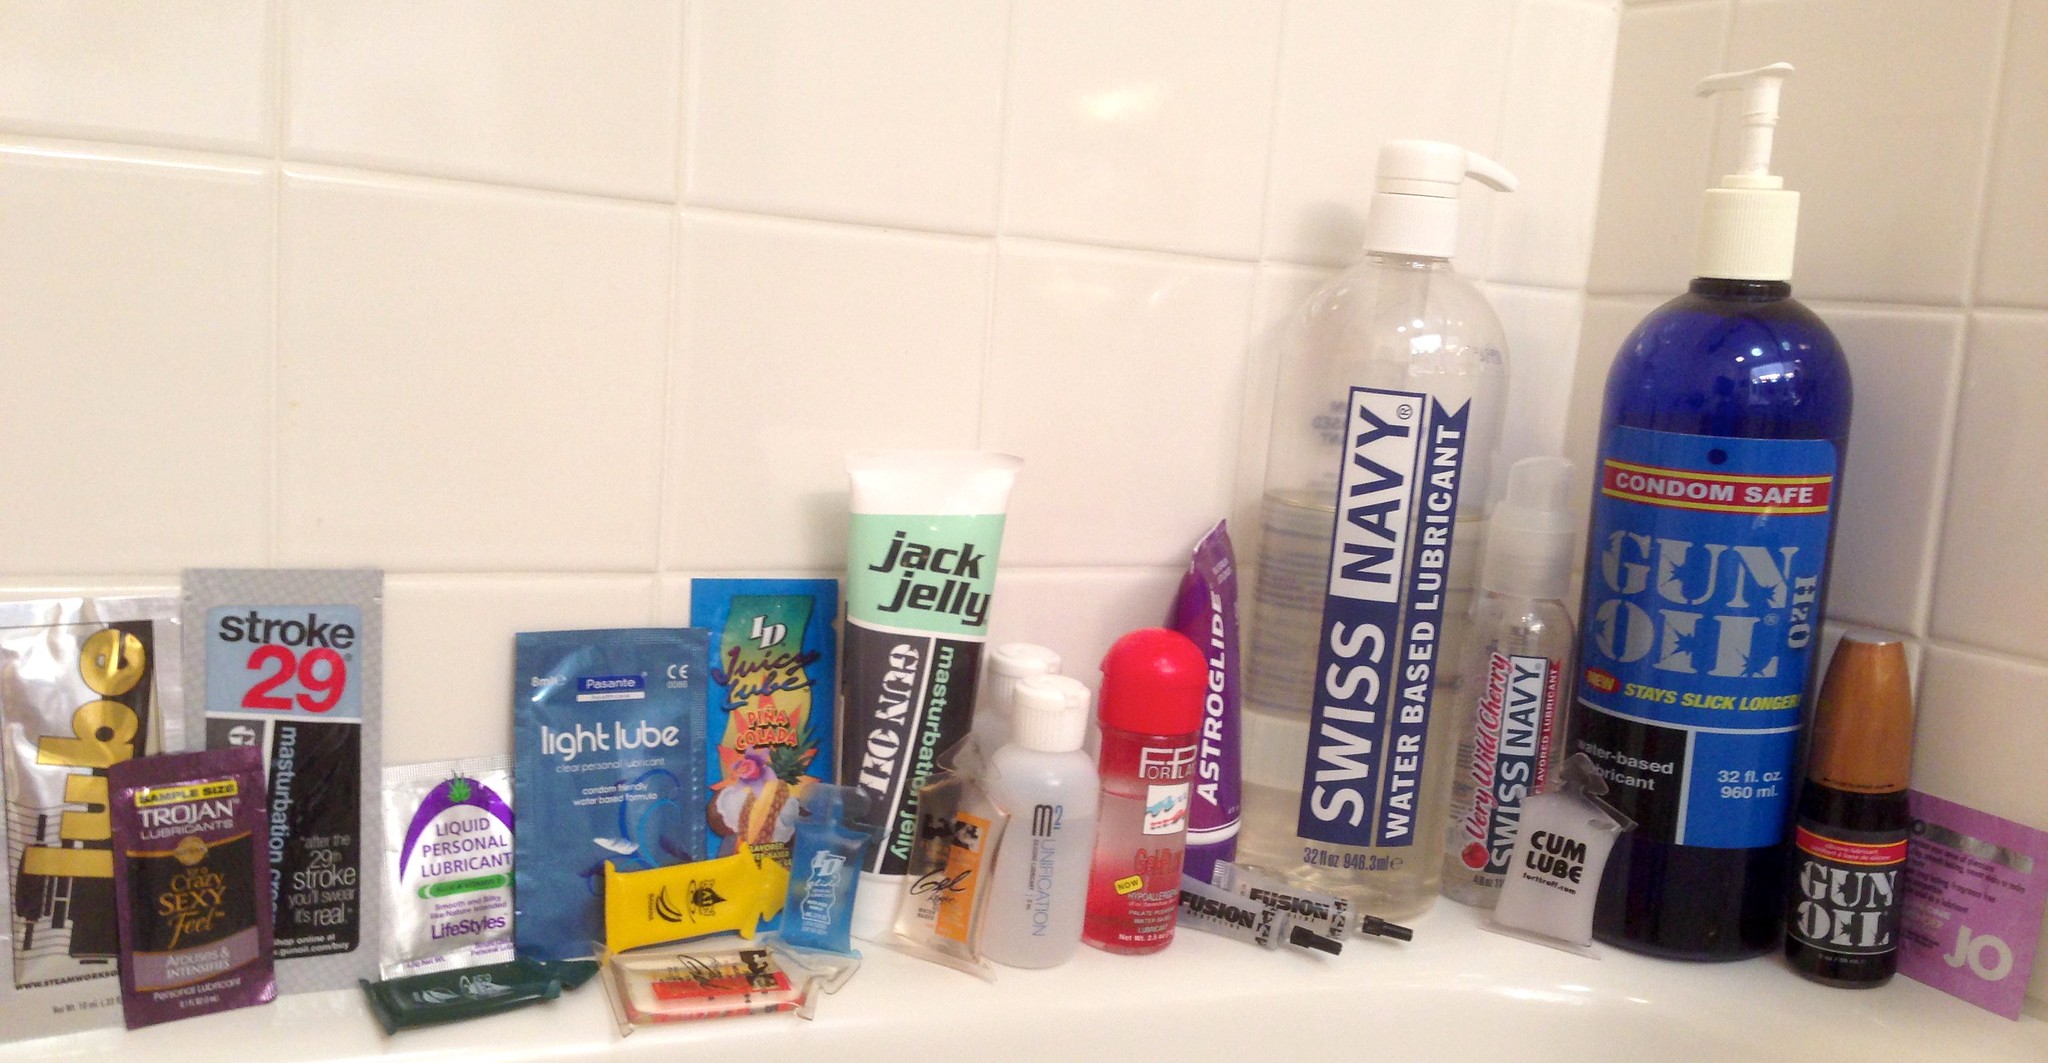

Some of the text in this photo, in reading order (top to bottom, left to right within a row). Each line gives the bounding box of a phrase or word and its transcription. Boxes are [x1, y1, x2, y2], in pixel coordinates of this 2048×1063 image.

[1615, 471, 1815, 504] CONDOM SAFE
[868, 530, 986, 579] jack
[1603, 530, 1799, 609] GUN
[877, 570, 991, 627] jelly
[1310, 405, 1411, 828] SWISS NAVY
[1788, 575, 1818, 649] H2O
[219, 611, 355, 649] stroke
[750, 615, 787, 650] ID
[1385, 425, 1461, 840] WATER BASED LUBRICANT
[1596, 599, 1778, 679] OIL
[240, 644, 347, 714] 29
[586, 678, 636, 690] Pasante
[711, 644, 821, 685] Juicy
[721, 670, 816, 712] Lube
[1196, 590, 1227, 806] ASTROGLIDE
[1480, 652, 1513, 732] Cherry
[1587, 671, 1615, 691] NEW
[1624, 683, 1679, 704] STAYS
[1682, 692, 1738, 709] SLICK
[736, 726, 799, 750] COLADA
[859, 644, 919, 795] GUN OIL
[541, 720, 679, 761] light lube
[1472, 724, 1499, 786] Wild
[1491, 664, 1540, 867] SWISS NAVY
[1717, 770, 1740, 783] 32
[269, 726, 297, 863] masturbation
[1721, 786, 1752, 799] 960
[138, 800, 233, 828] TROJAN
[435, 817, 490, 837] LIQUID
[1466, 789, 1499, 840] Very
[421, 852, 512, 877] LUBRICANT
[422, 835, 508, 858] PERSONAL
[1304, 847, 1318, 864] 32
[1526, 850, 1583, 884] LUBE
[1530, 830, 1587, 864] CUM
[293, 864, 357, 891] stroke
[1032, 839, 1056, 937] UNIFICATION
[1117, 879, 1140, 891] NOW
[1801, 861, 1897, 908] GUN
[158, 886, 227, 917] SEXY
[1180, 889, 1257, 929] FUSION
[1250, 887, 1330, 920] FUSION
[431, 915, 506, 939] LifeStyles
[1797, 901, 1889, 947] OIL
[1944, 925, 2013, 982] JO
